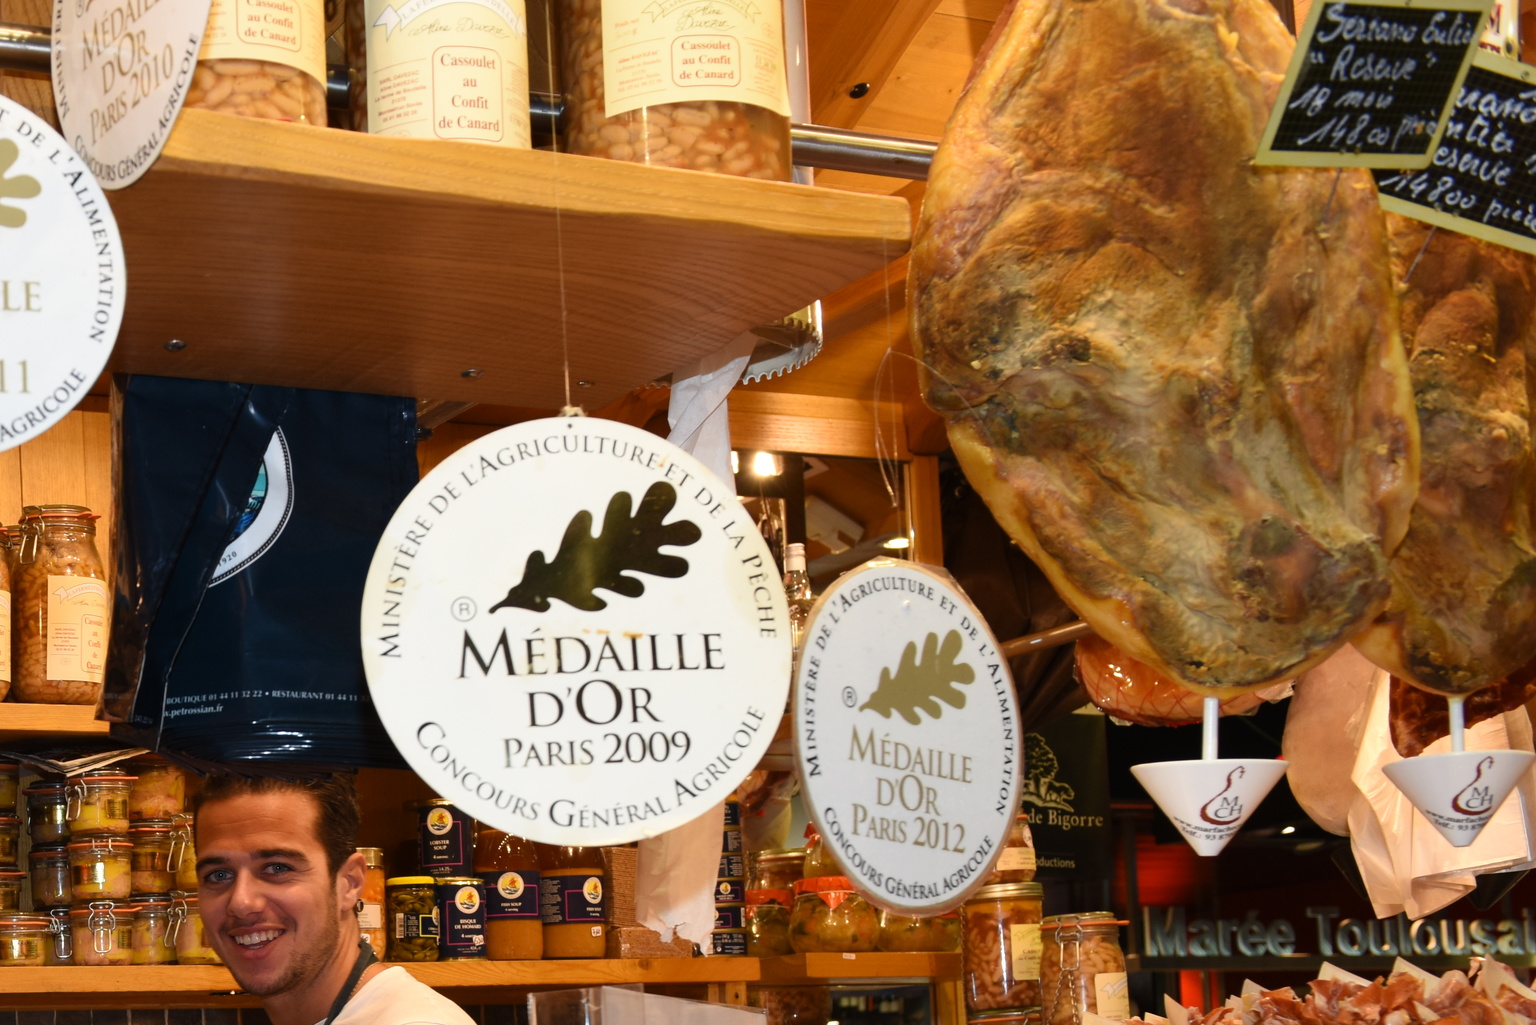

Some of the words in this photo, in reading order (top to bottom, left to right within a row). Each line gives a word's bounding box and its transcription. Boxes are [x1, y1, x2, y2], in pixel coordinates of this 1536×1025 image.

[244, 27, 258, 38] de
[260, 28, 297, 46] Canard
[247, 13, 261, 23] au
[263, 14, 294, 29] Confit
[440, 53, 496, 70] Cassoulet
[681, 41, 731, 50] Cassoulet
[682, 57, 695, 66] au
[698, 55, 731, 65] Confit
[89, 86, 128, 148] PARIS
[130, 43, 175, 110] 2010
[157, 33, 201, 133] AGRICOLE
[463, 77, 477, 88] au
[679, 70, 692, 80] de
[695, 69, 734, 80] Canard
[438, 116, 453, 129] de
[457, 115, 500, 132] Canard
[451, 94, 489, 110] Confit
[15, 120, 46, 151] DE
[47, 149, 115, 343] L'ALIMENTATION
[376, 518, 434, 659] MINISTÈRE
[429, 481, 463, 516] DE
[460, 433, 658, 489] L'AGRICULTURE
[663, 460, 695, 490] ET
[692, 485, 728, 521] DE
[720, 520, 747, 552] LA
[740, 552, 780, 640] PÊCHE
[455, 626, 726, 680] MÉDAILLE
[166, 694, 207, 706] BOUTIQUE
[271, 689, 324, 700] RESTAURANT
[525, 679, 665, 729] D'OR
[804, 655, 823, 779] MINISTÈRE
[814, 625, 833, 652] DE
[829, 575, 935, 627] L'AGRICULTURE
[939, 596, 958, 617] ET
[959, 615, 980, 642] DE
[977, 641, 1016, 817] L'ALIMENTATION
[415, 719, 543, 822] CONCOURS
[548, 796, 672, 830] GÉNÉRAL
[671, 704, 768, 809] AGRICOLE
[501, 737, 595, 770] PARIS
[602, 730, 693, 764] 2009
[847, 722, 974, 786] MÉDAILLE
[875, 773, 942, 818] D'OR
[850, 802, 908, 845] PARIS
[911, 815, 967, 854] 2012
[1028, 810, 1043, 824] de
[1048, 809, 1104, 831] Bigorre
[822, 806, 884, 889] CONCOURS
[883, 876, 942, 902] GÉNÉRAL
[942, 834, 996, 895] AGRICOLE
[1142, 904, 1296, 957] Marée
